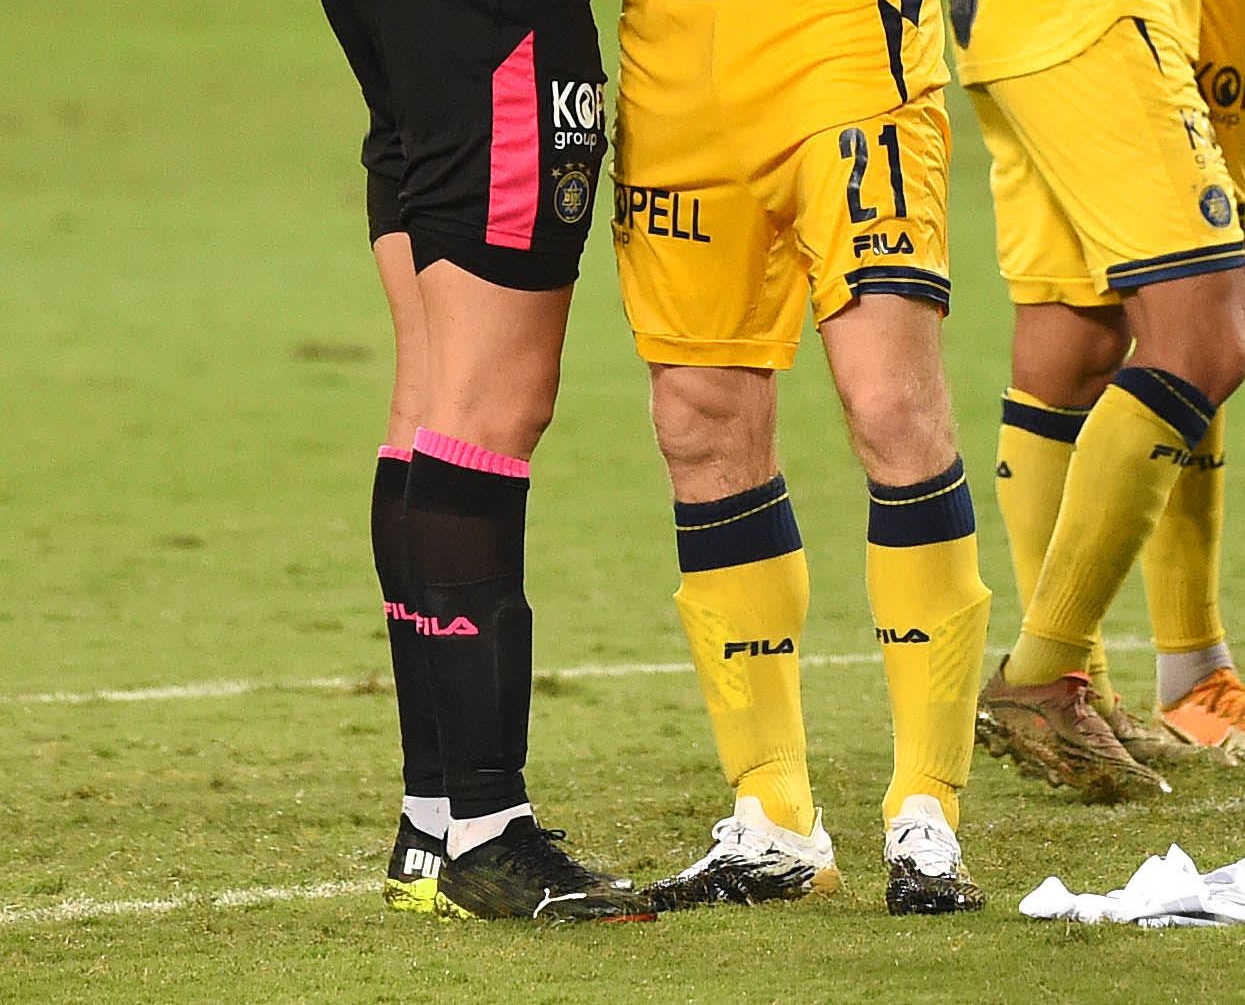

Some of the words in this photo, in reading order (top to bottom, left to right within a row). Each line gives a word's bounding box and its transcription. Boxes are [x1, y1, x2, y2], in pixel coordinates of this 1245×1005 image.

[551, 80, 605, 130] KOP
[554, 130, 598, 153] group
[838, 124, 907, 224] 21
[614, 184, 711, 243] OPELL
[853, 231, 914, 258] FILA
[416, 615, 479, 636] FILA
[723, 637, 795, 660] FILA
[403, 848, 442, 880] PU
